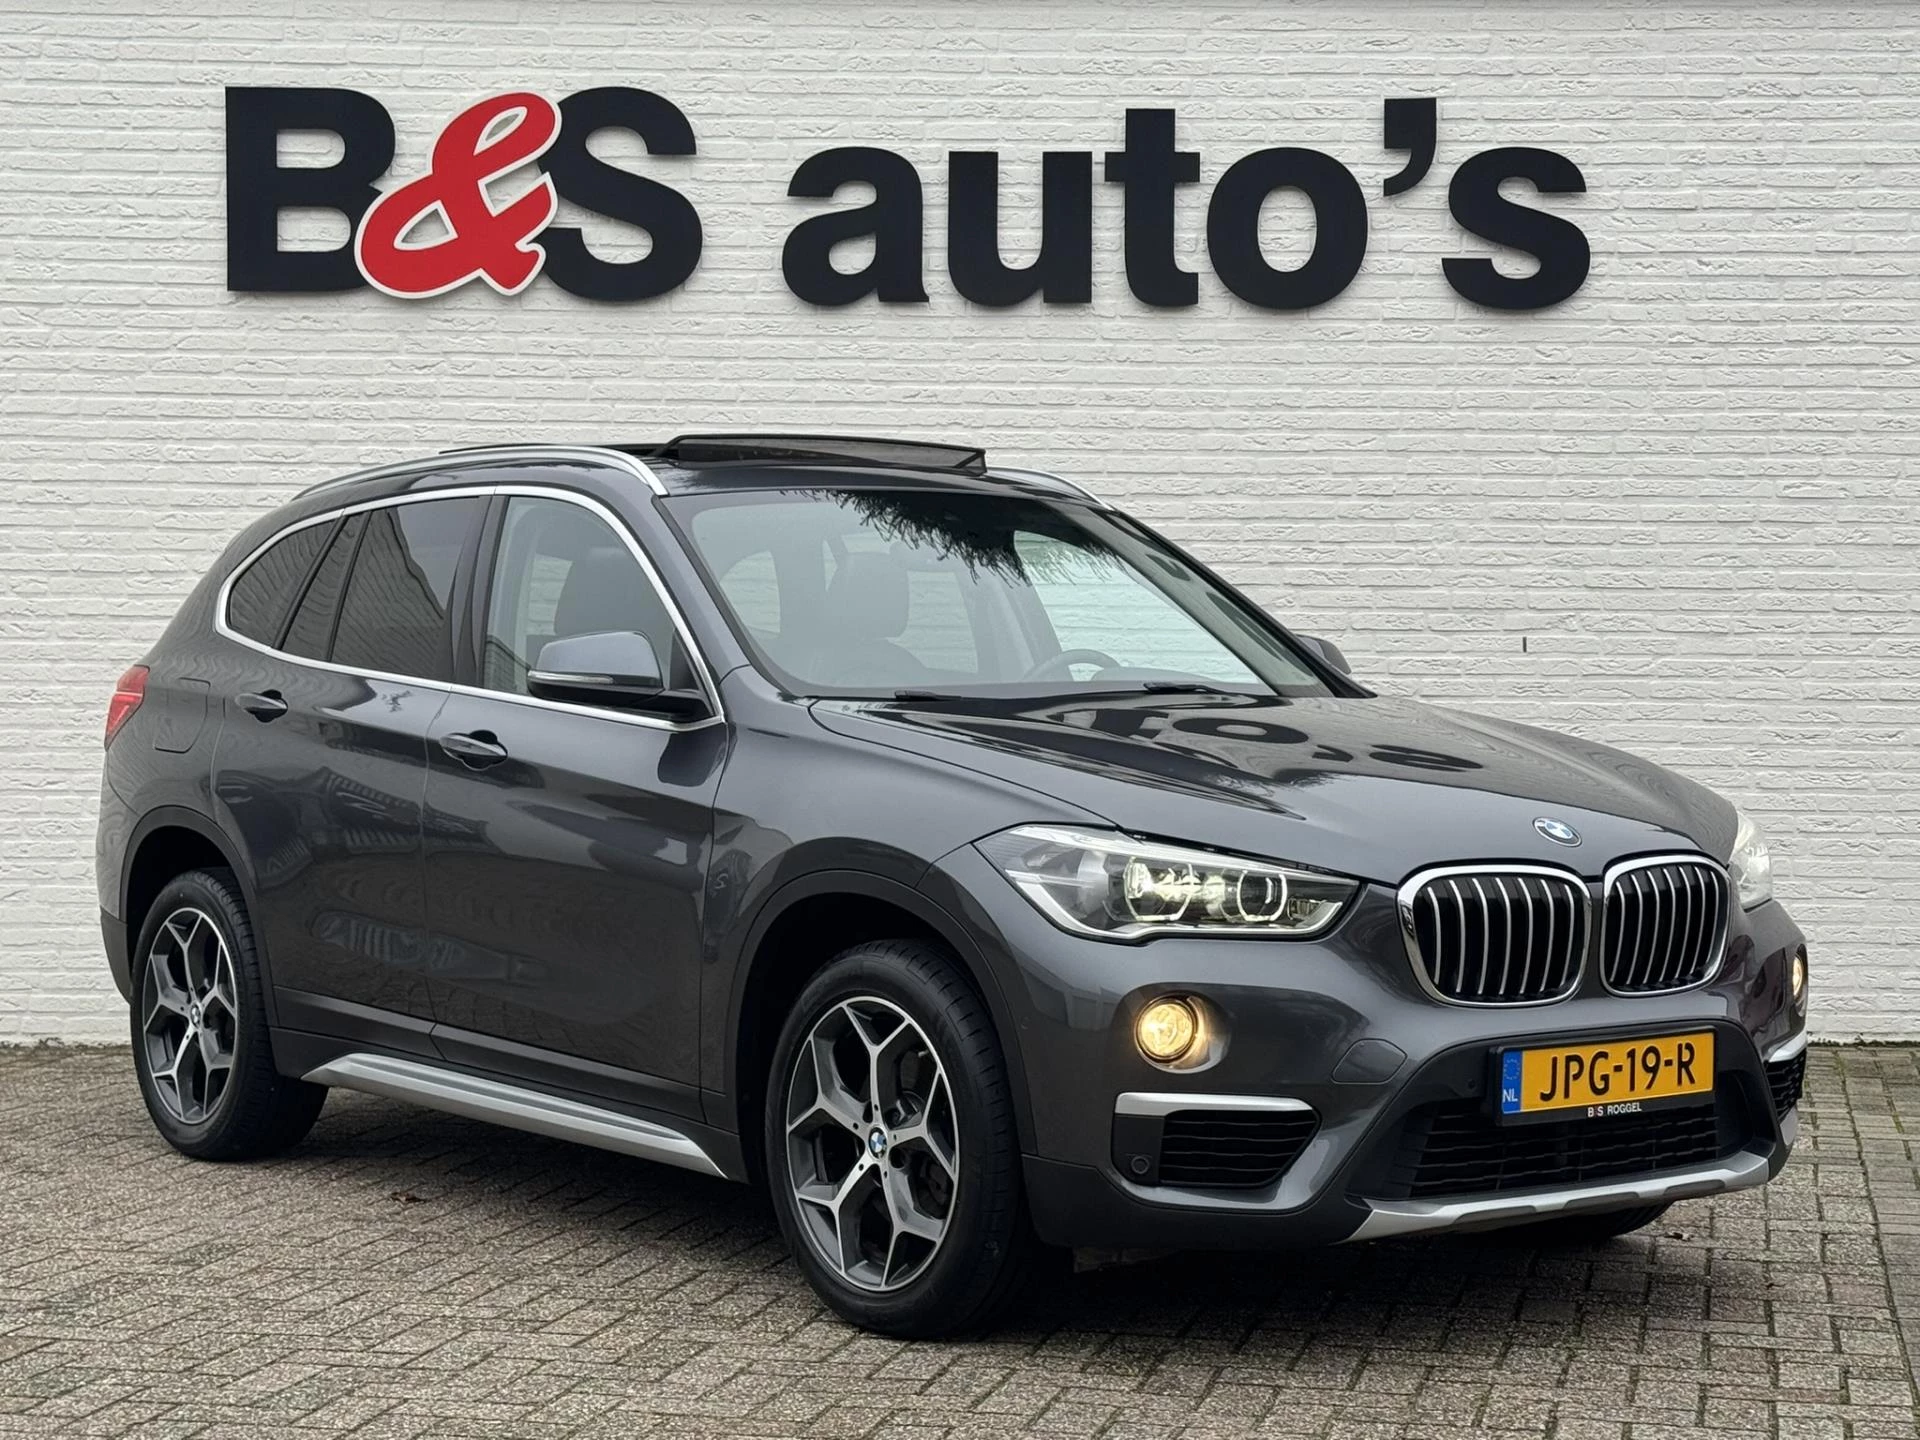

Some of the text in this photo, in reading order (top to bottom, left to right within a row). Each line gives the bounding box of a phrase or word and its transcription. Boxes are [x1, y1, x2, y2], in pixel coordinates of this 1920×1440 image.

[225, 86, 1591, 310] B&S auto's
[1539, 1042, 1696, 1102] JPG-19-R
[1502, 1089, 1518, 1103] NL
[1607, 1102, 1642, 1115] ROGGEL
